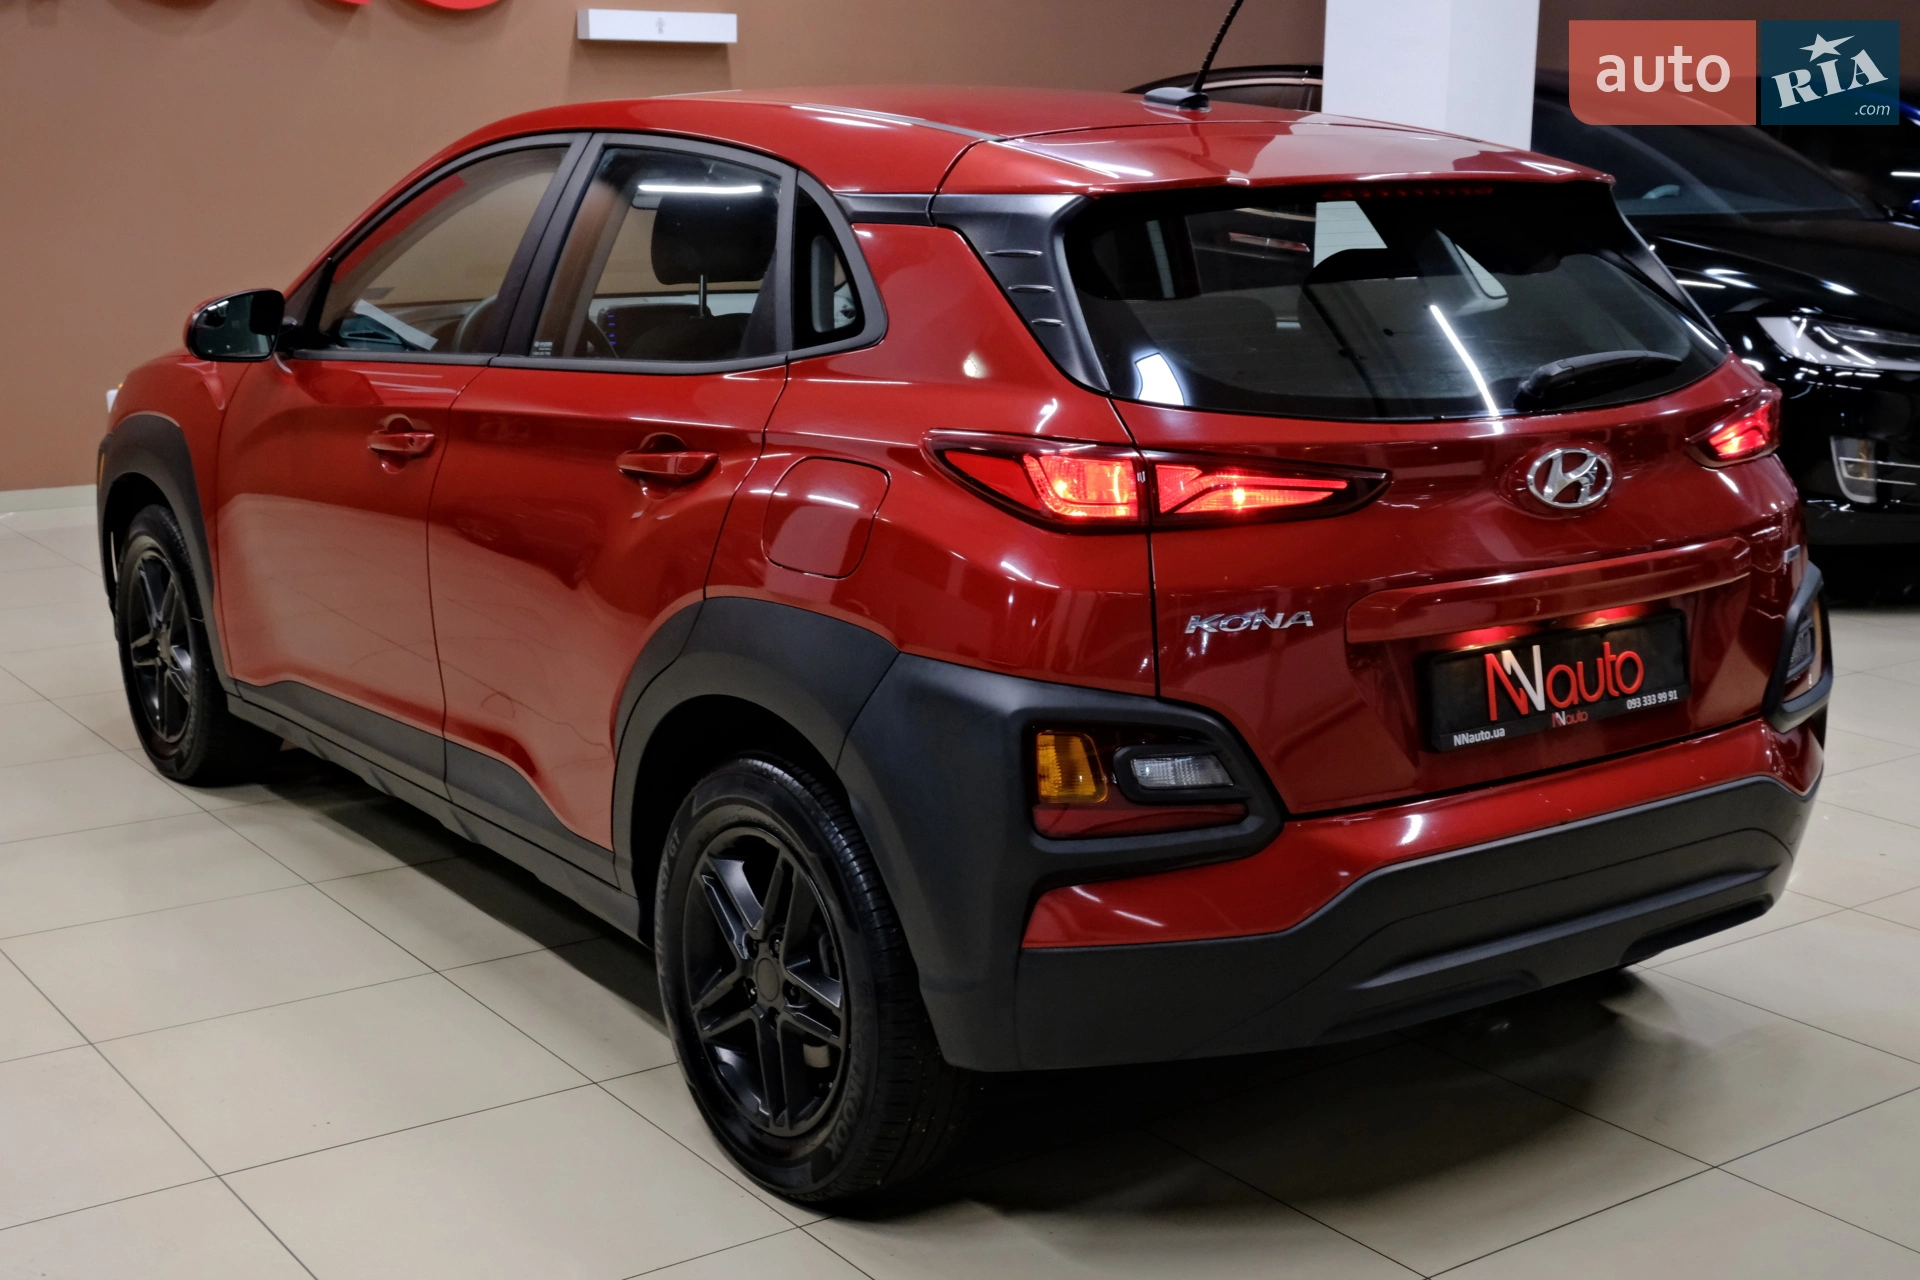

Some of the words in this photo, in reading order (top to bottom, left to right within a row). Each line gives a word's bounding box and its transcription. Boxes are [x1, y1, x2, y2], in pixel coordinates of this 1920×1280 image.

[1184, 610, 1314, 634] KONA
[1626, 697, 1641, 709] 093
[1642, 694, 1657, 706] 333
[1657, 691, 1668, 703] 99
[1668, 690, 1678, 701] 91
[1453, 727, 1506, 747] NNauto.ua
